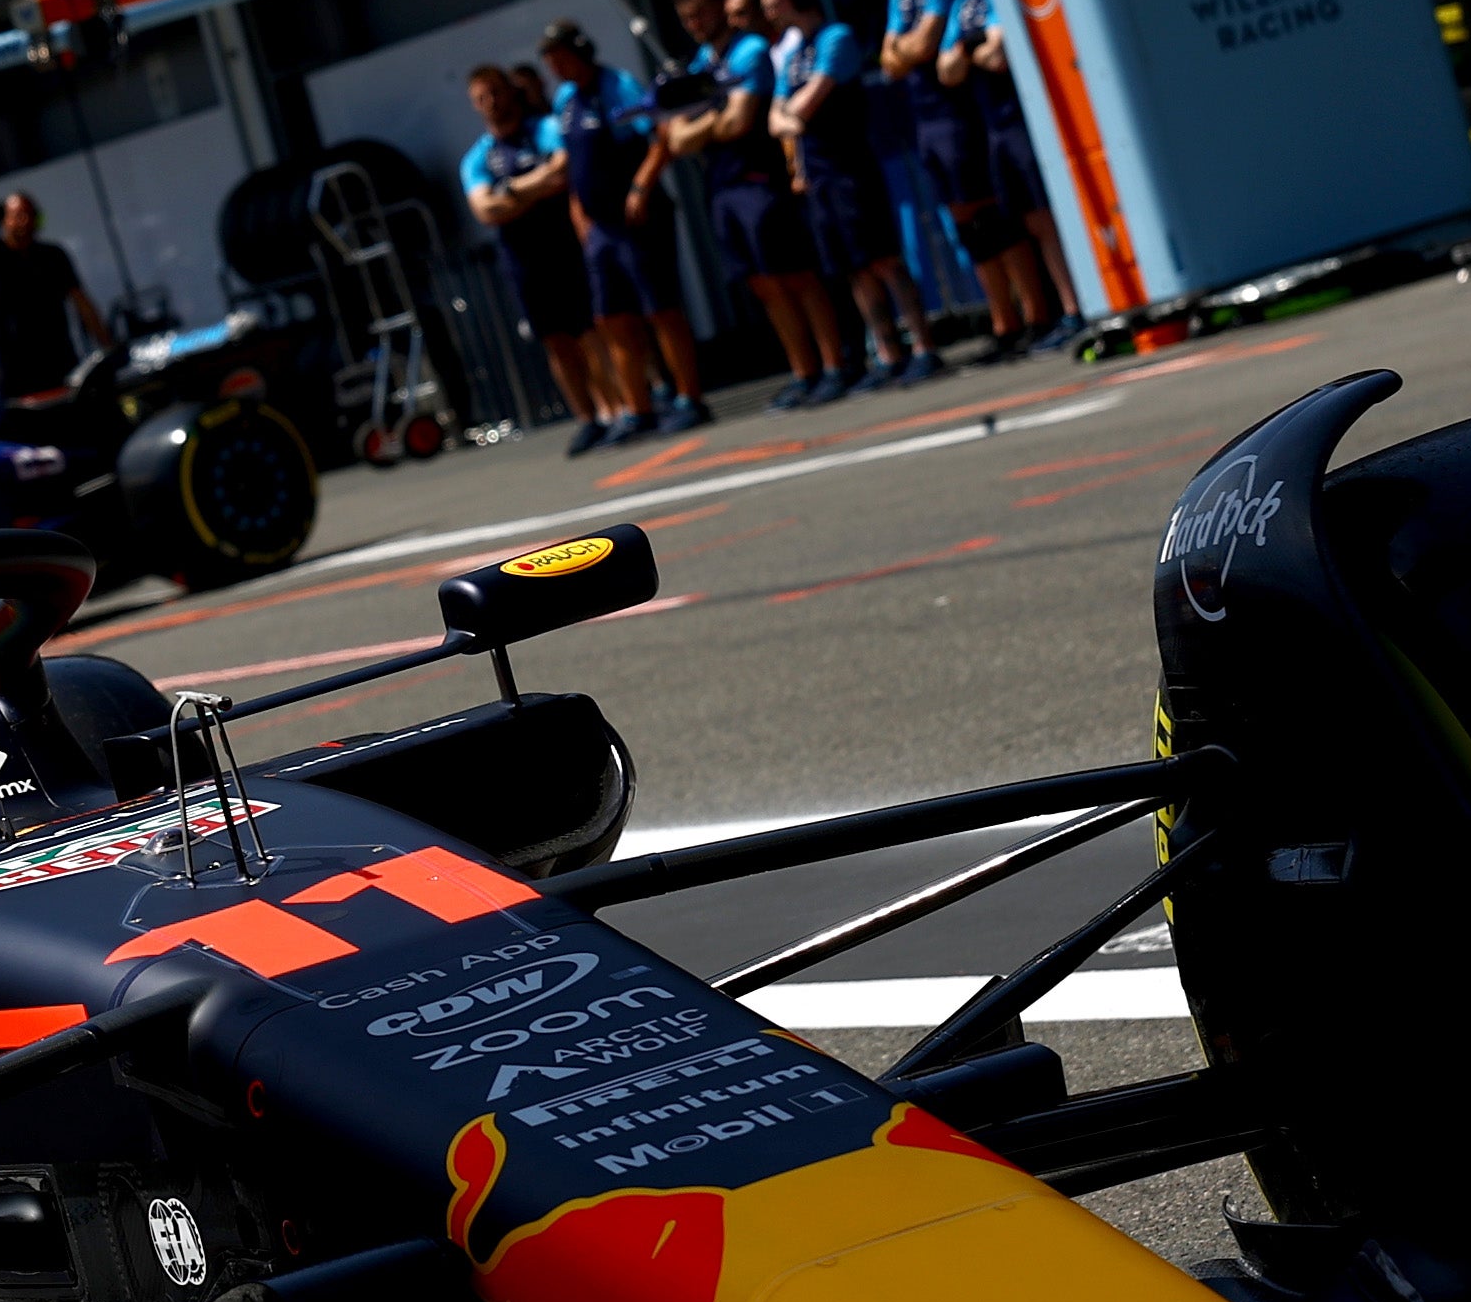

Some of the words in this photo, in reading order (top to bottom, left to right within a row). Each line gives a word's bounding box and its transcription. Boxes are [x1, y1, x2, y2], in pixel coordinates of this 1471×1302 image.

[529, 542, 601, 567] RAUCH
[1160, 506, 1215, 563] Hard
[318, 967, 448, 1010] Cash
[461, 934, 561, 971] App
[366, 969, 544, 1036] CDW
[411, 986, 676, 1071] zoom
[553, 1008, 709, 1063] ARCTIC
[583, 1022, 708, 1065] WOLF
[510, 1037, 776, 1127] PIRELLI
[554, 1063, 819, 1150] infinitum
[594, 1104, 796, 1175] Mobil
